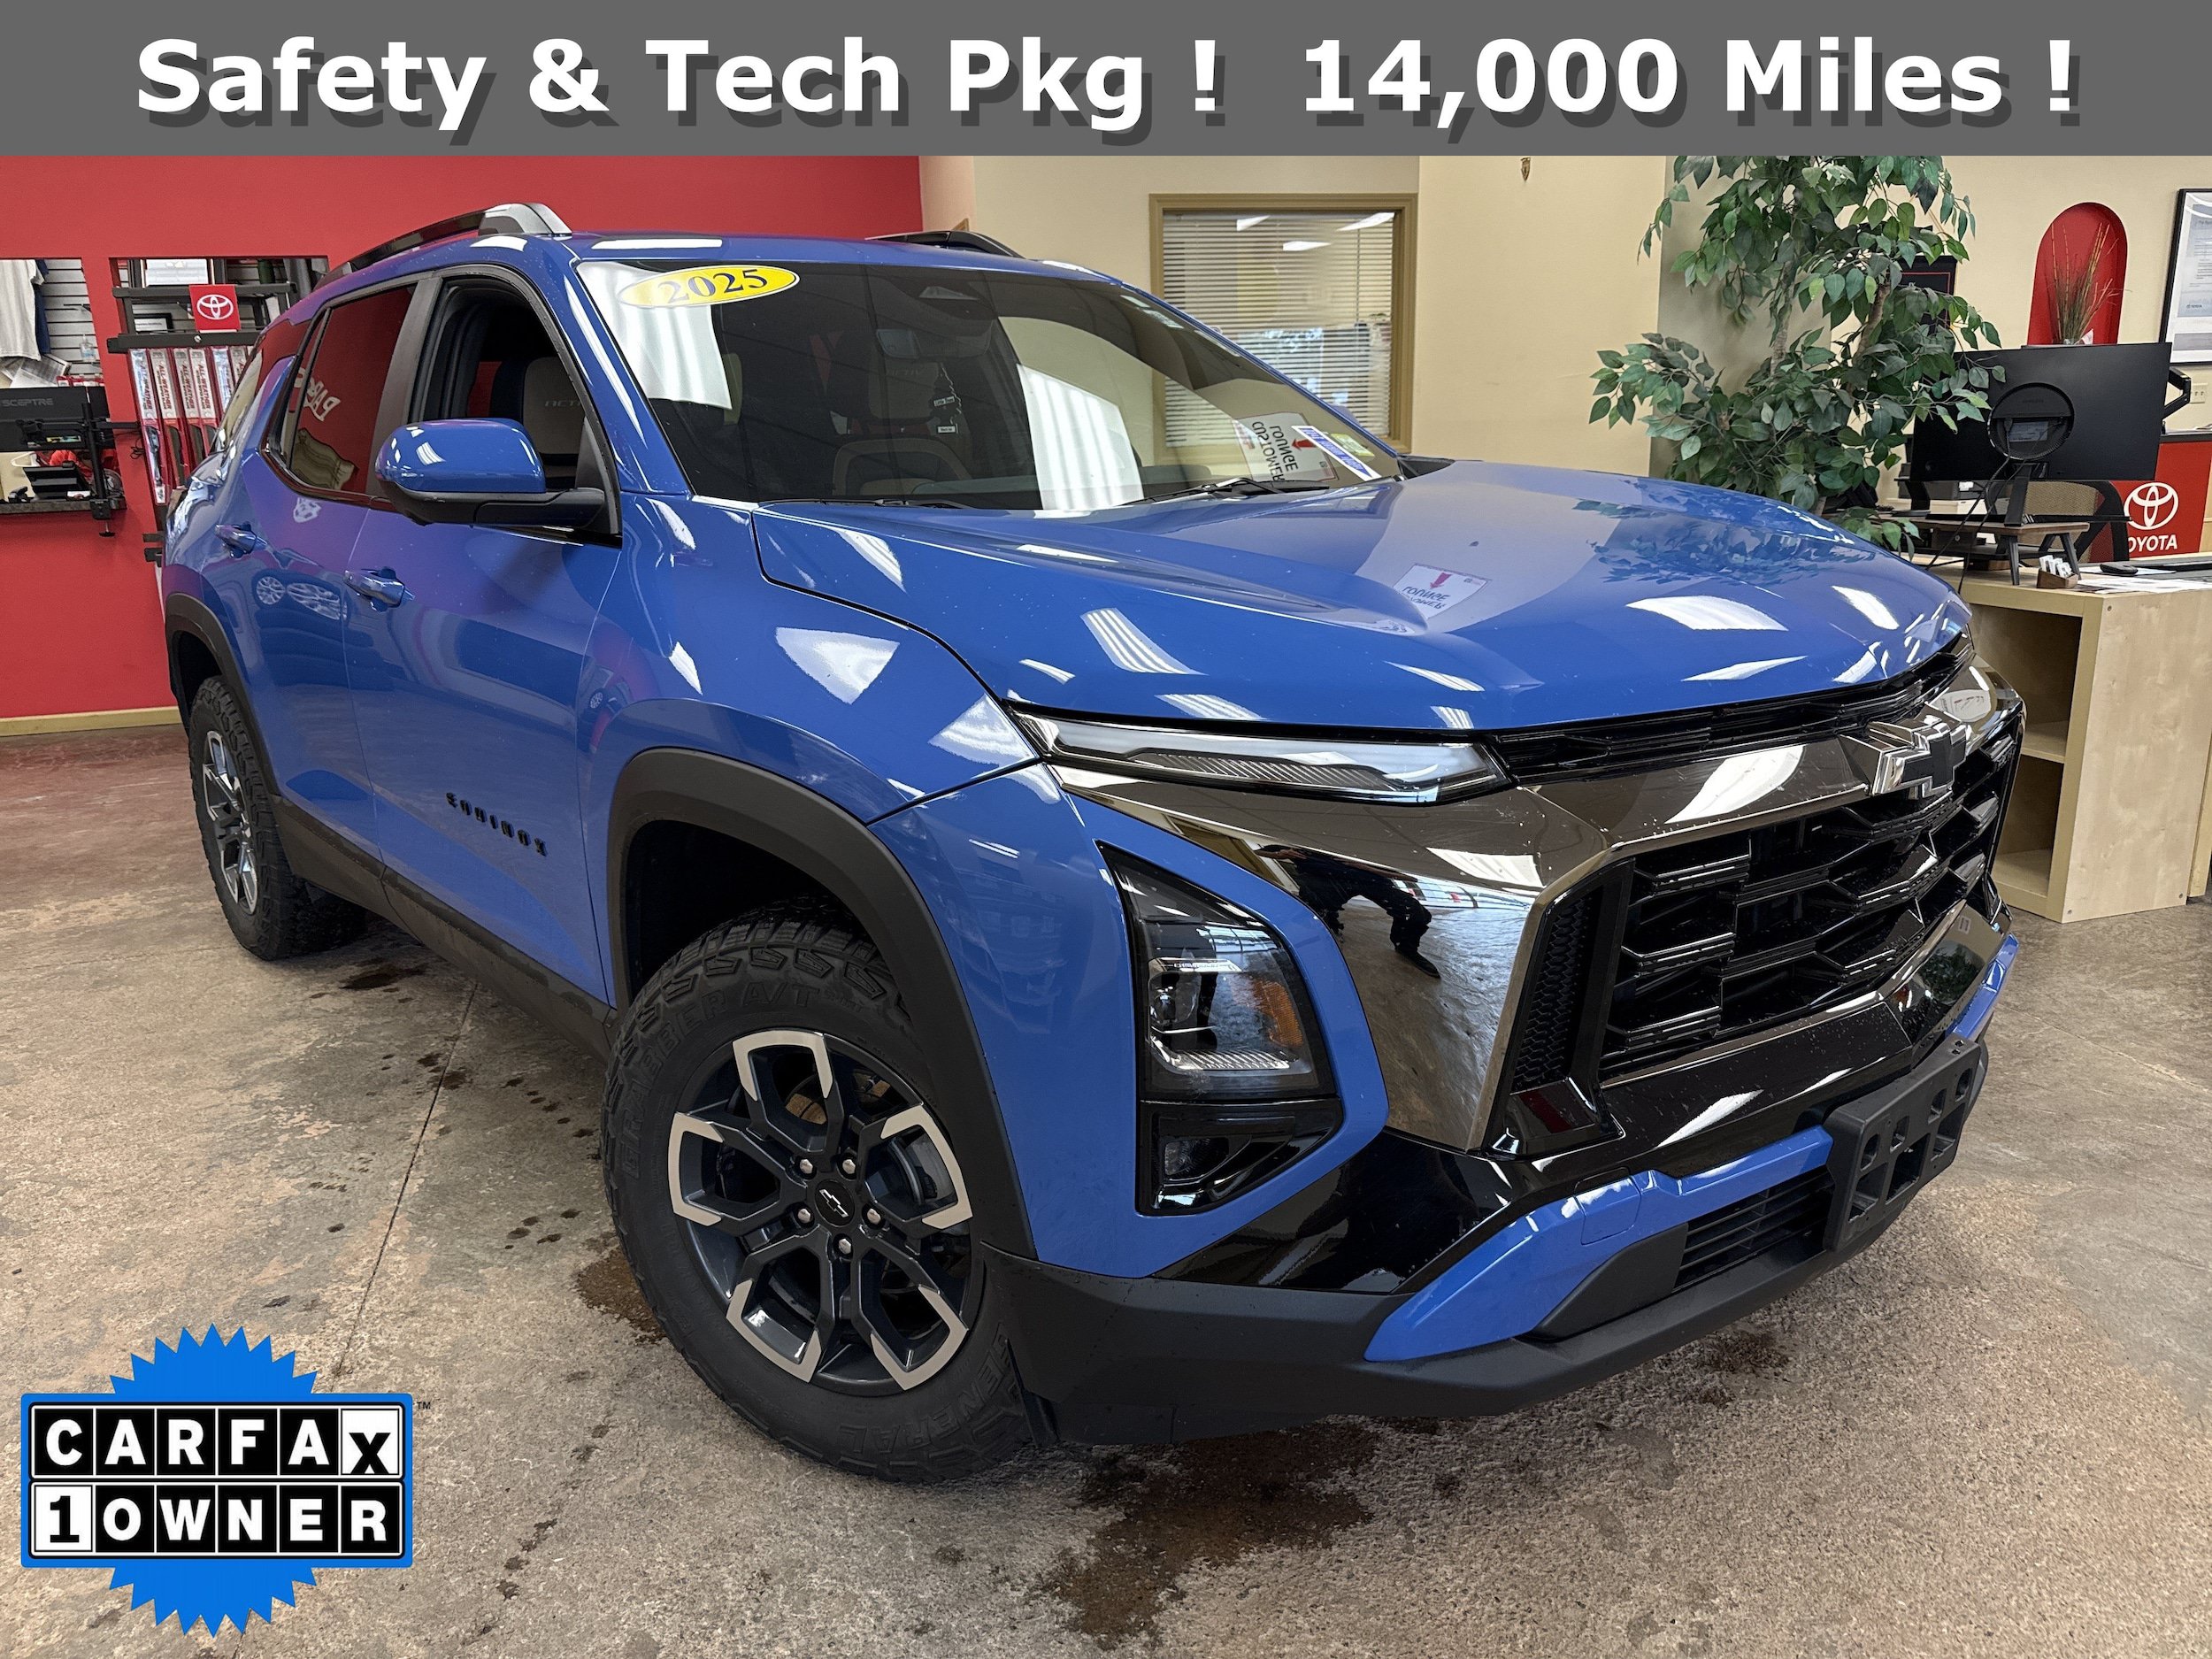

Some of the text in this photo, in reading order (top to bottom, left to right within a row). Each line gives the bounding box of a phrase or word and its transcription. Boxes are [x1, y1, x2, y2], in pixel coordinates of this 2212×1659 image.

[658, 269, 768, 304] 2025
[1, 398, 54, 407] SCEPTRE
[158, 364, 172, 410] ALL-WEATHER
[197, 364, 211, 409] ALL-WEATHER
[2127, 534, 2178, 553] OYOTA
[446, 792, 548, 857] EQUINOX
